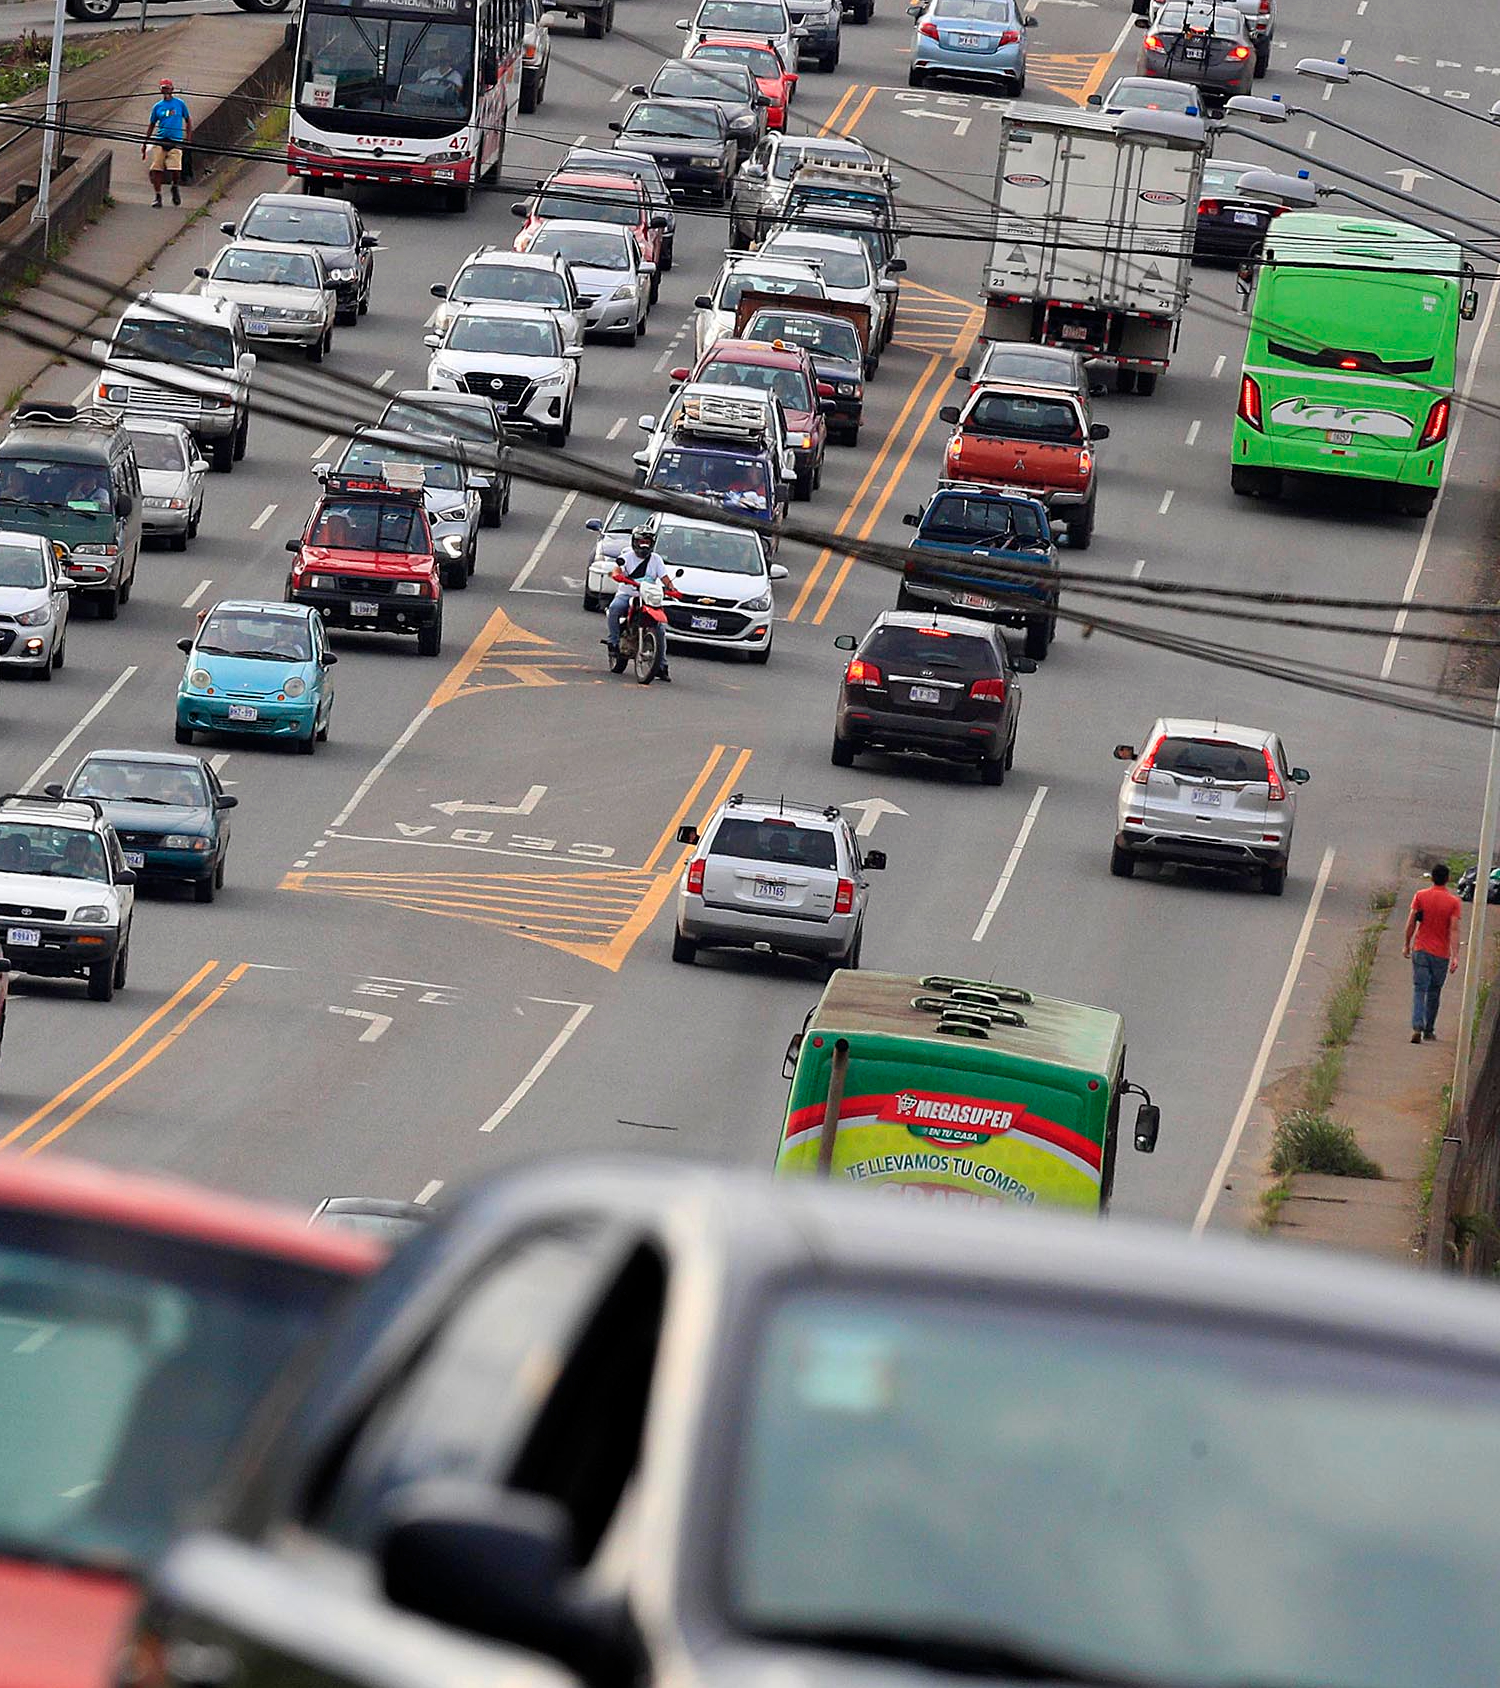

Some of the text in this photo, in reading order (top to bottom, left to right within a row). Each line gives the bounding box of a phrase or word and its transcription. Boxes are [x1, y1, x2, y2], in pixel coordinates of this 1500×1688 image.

[894, 92, 1009, 112] CED
[448, 137, 469, 151] 47
[992, 278, 1005, 287] 23
[1158, 300, 1169, 308] 23
[394, 821, 615, 858] CEDA
[915, 1098, 1013, 1130] MEGASUPER
[928, 1127, 978, 1142] EN TU CASA
[845, 1154, 1037, 1206] TE LLEVAMOS TU COMPRA
